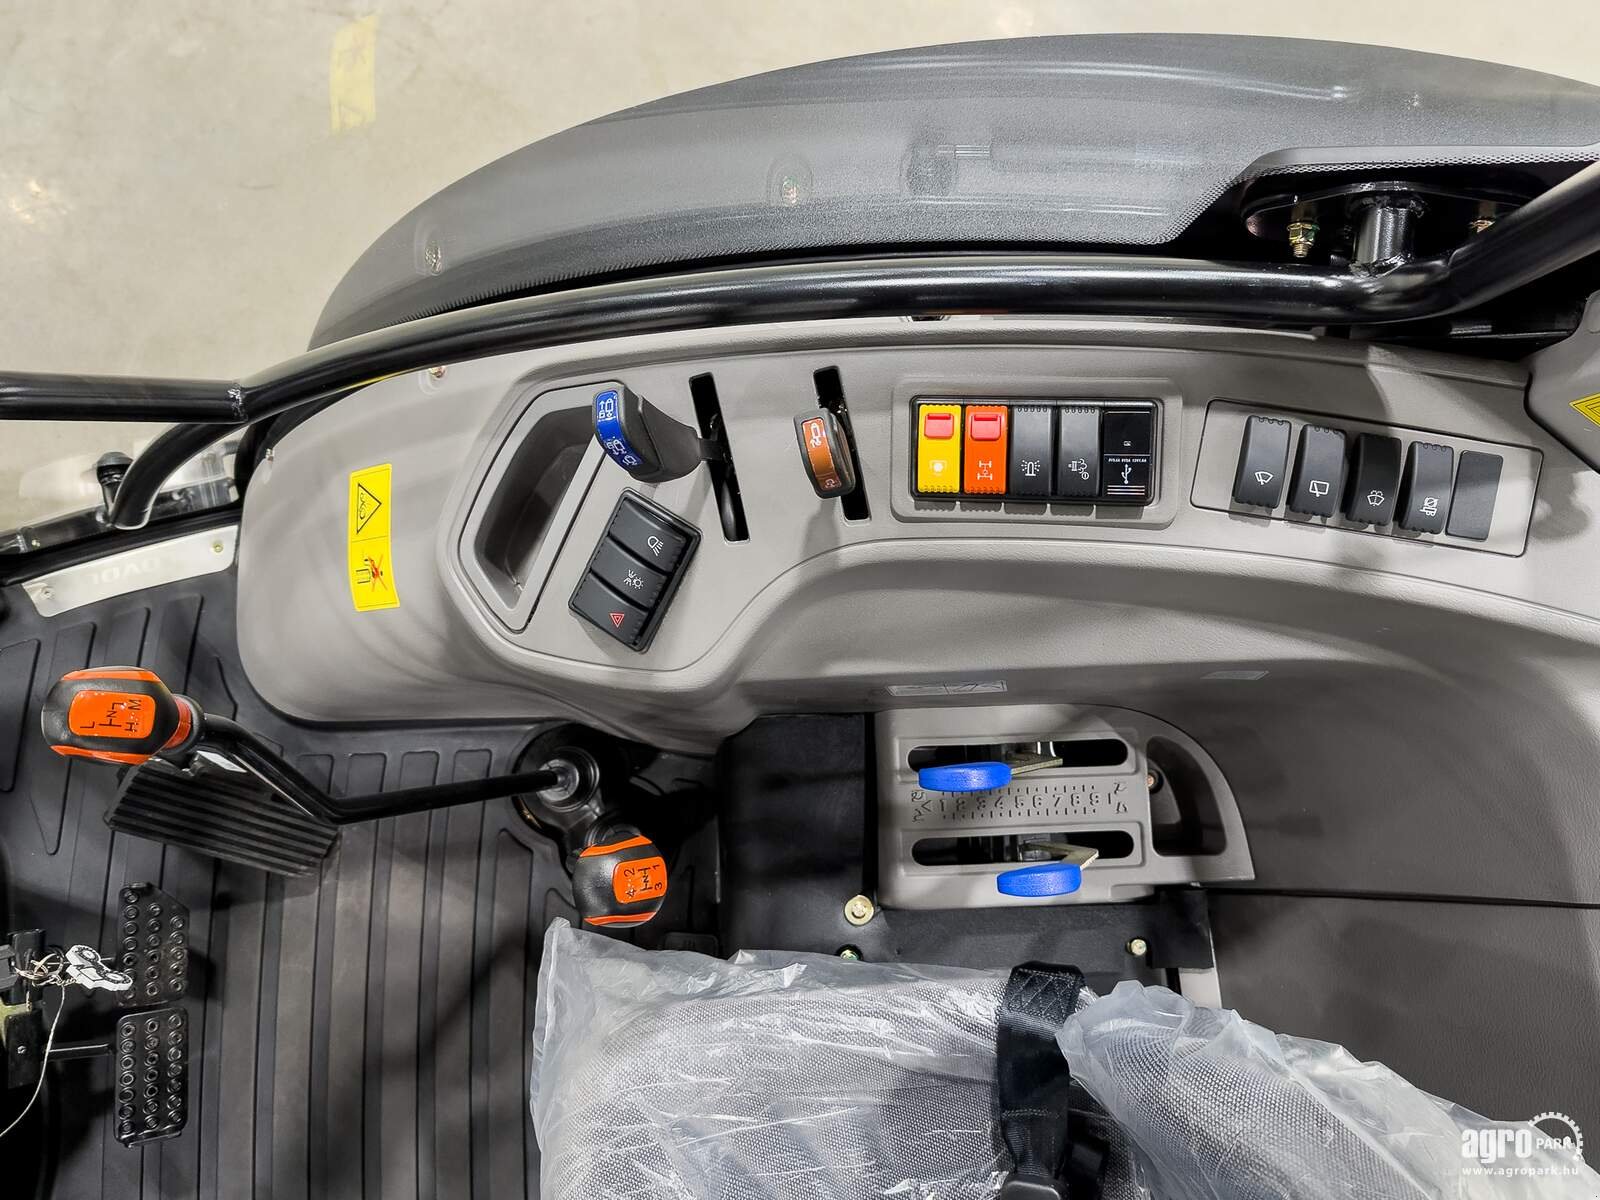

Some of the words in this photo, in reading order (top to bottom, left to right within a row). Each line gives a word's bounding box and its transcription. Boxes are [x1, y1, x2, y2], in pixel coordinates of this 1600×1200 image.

[128, 699, 141, 710] M
[624, 868, 635, 877] 2
[654, 882, 663, 890] 3
